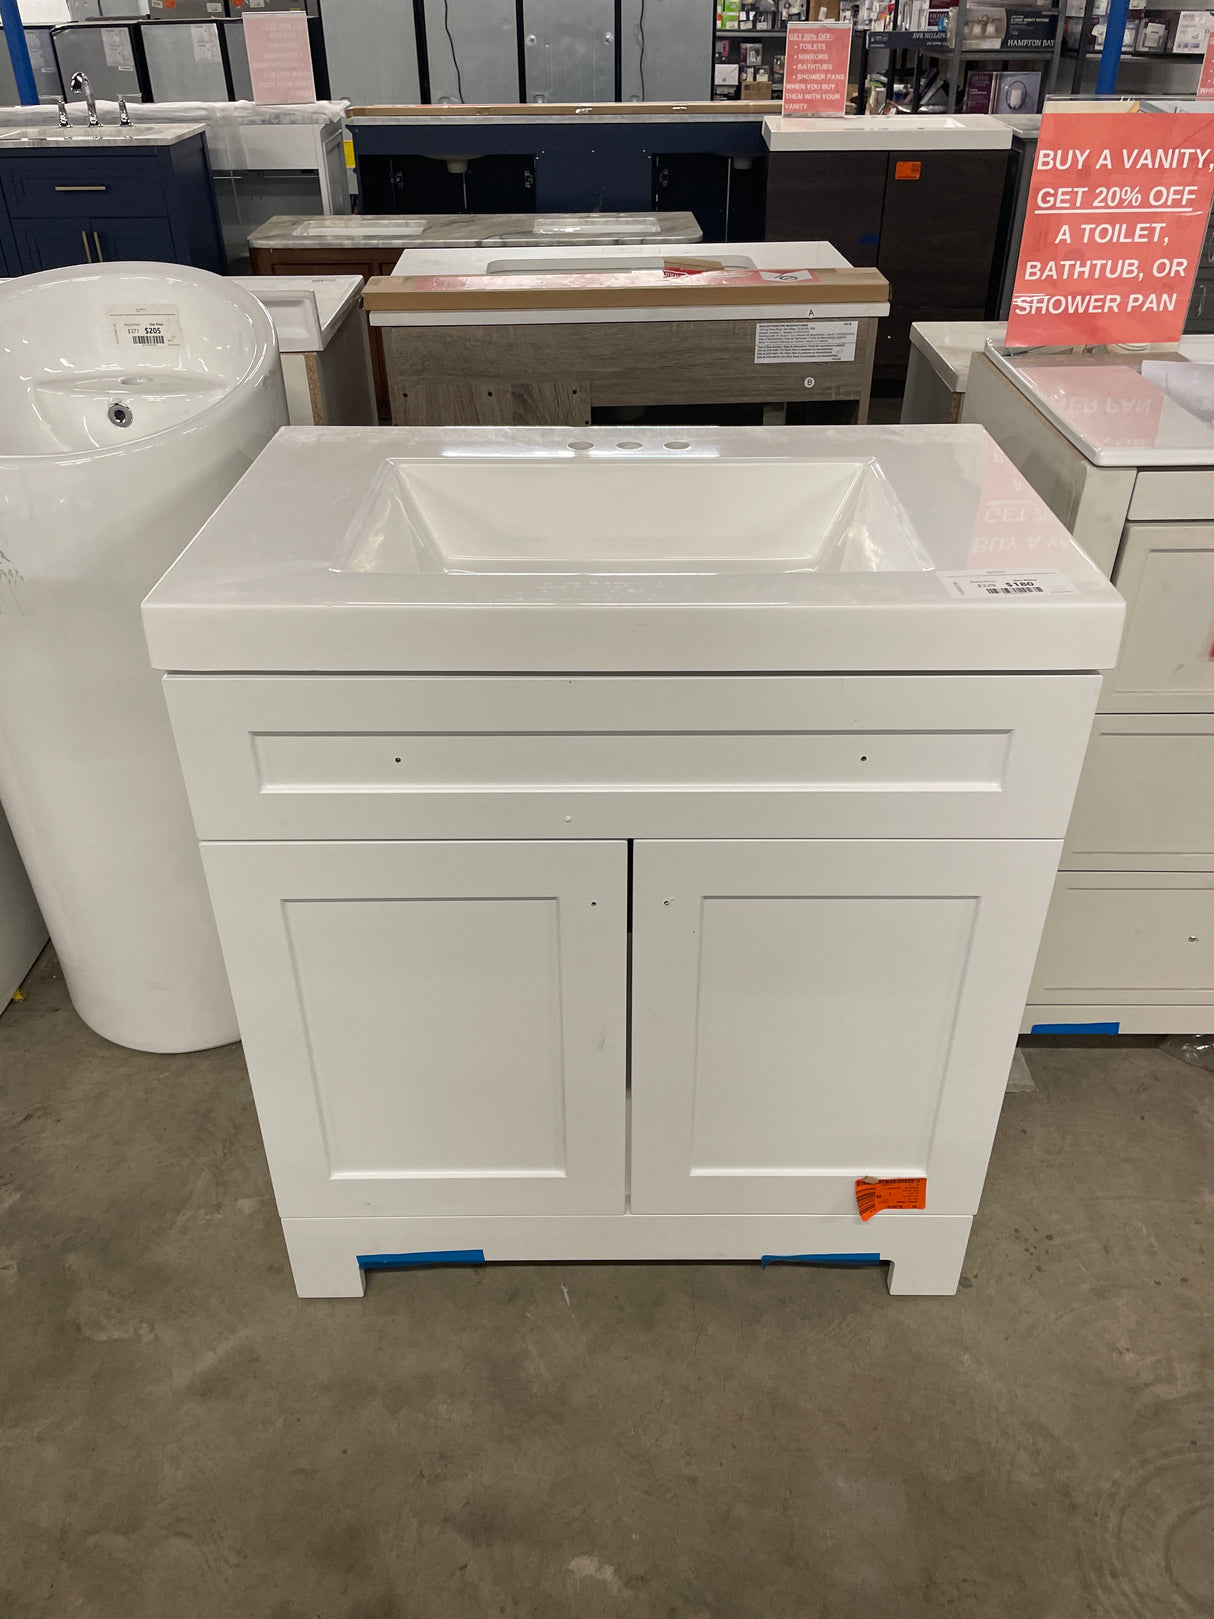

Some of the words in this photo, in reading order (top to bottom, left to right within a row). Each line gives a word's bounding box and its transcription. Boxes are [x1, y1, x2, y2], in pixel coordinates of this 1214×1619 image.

[1007, 39, 1042, 47] HAMPTON
[1042, 39, 1055, 47] BAY
[1036, 149, 1090, 171] BUY
[1096, 148, 1113, 170] A
[1122, 148, 1214, 173] VANITY,
[1036, 187, 1089, 208] GET
[1092, 186, 1142, 207] 20%
[1148, 185, 1198, 207] OFF
[1054, 224, 1072, 244] A
[1081, 222, 1170, 246] TOILET,
[1024, 258, 1145, 282] BATHTUB,
[1151, 257, 1188, 278] OR
[808, 309, 815, 317] A
[1014, 294, 1121, 315] SHOWER
[1126, 292, 1177, 313] PAN
